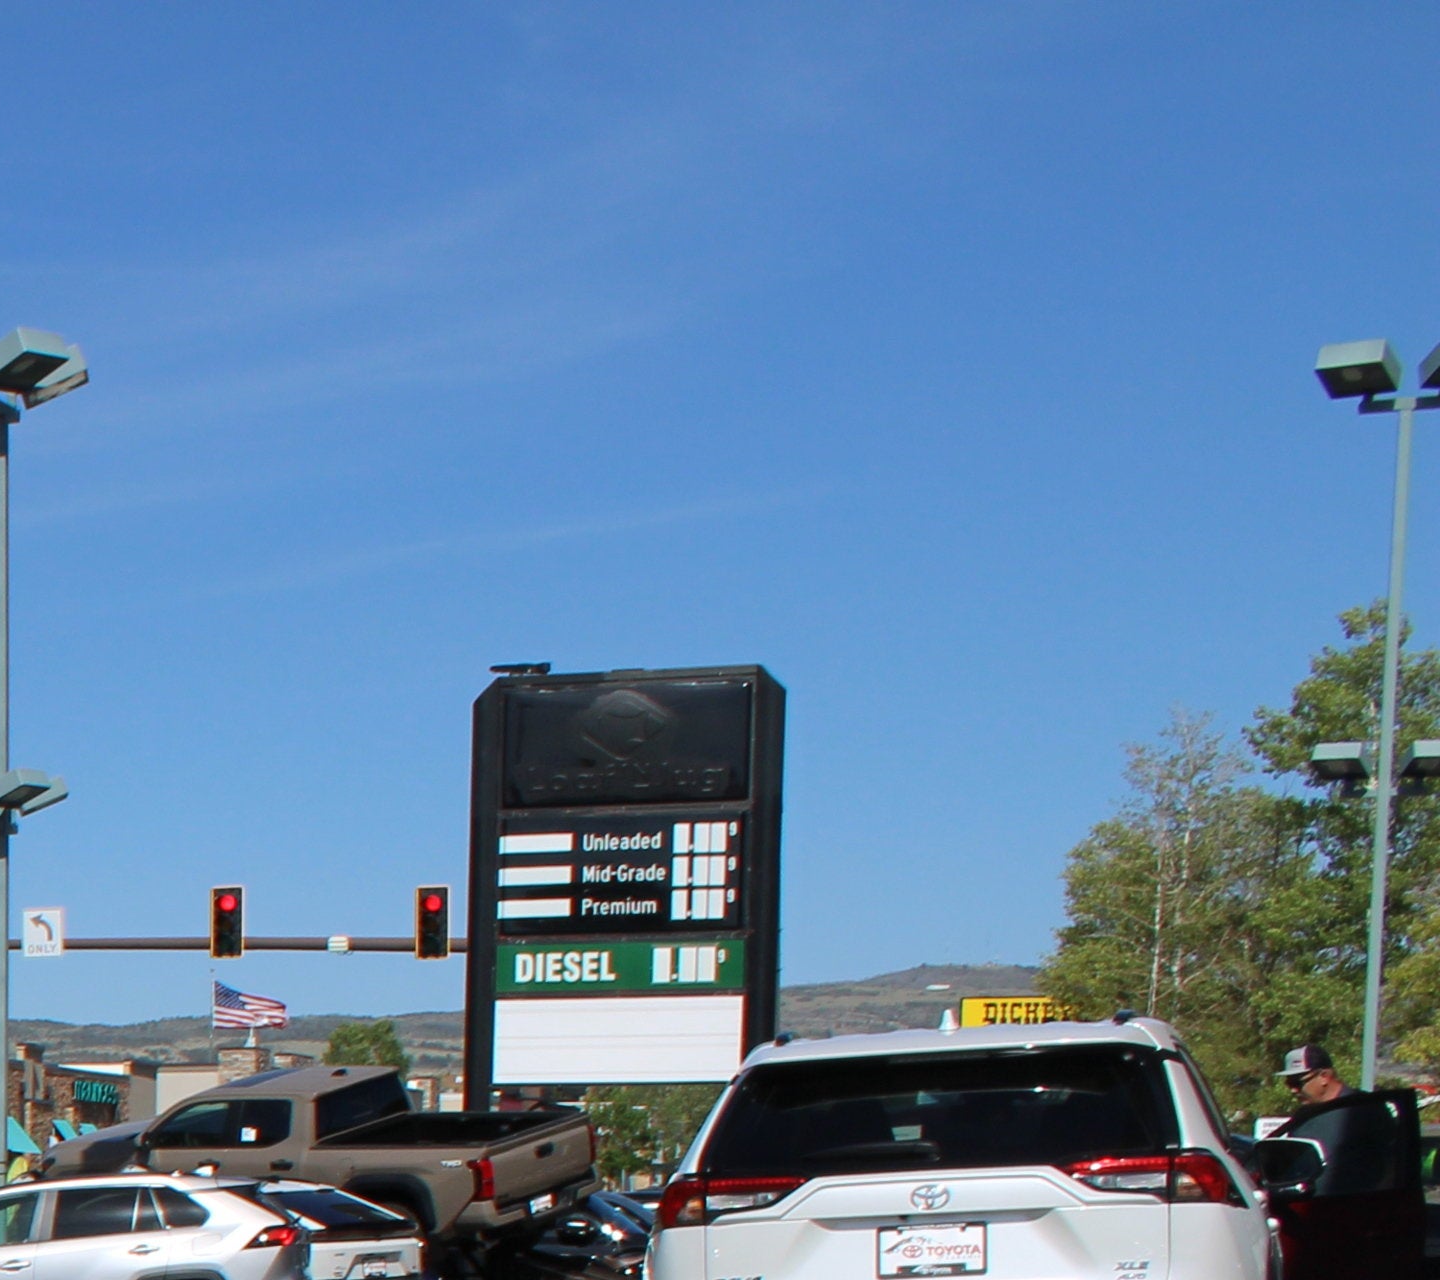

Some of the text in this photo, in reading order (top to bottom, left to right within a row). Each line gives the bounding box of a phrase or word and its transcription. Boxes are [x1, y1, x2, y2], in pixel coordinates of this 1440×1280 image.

[583, 831, 662, 852] Unleaded
[582, 863, 667, 883] Mid-Grade
[581, 896, 657, 916] Premium
[27, 943, 58, 955] ONLY
[514, 951, 617, 984] DIESEL
[926, 1244, 982, 1257] TOYOTA
